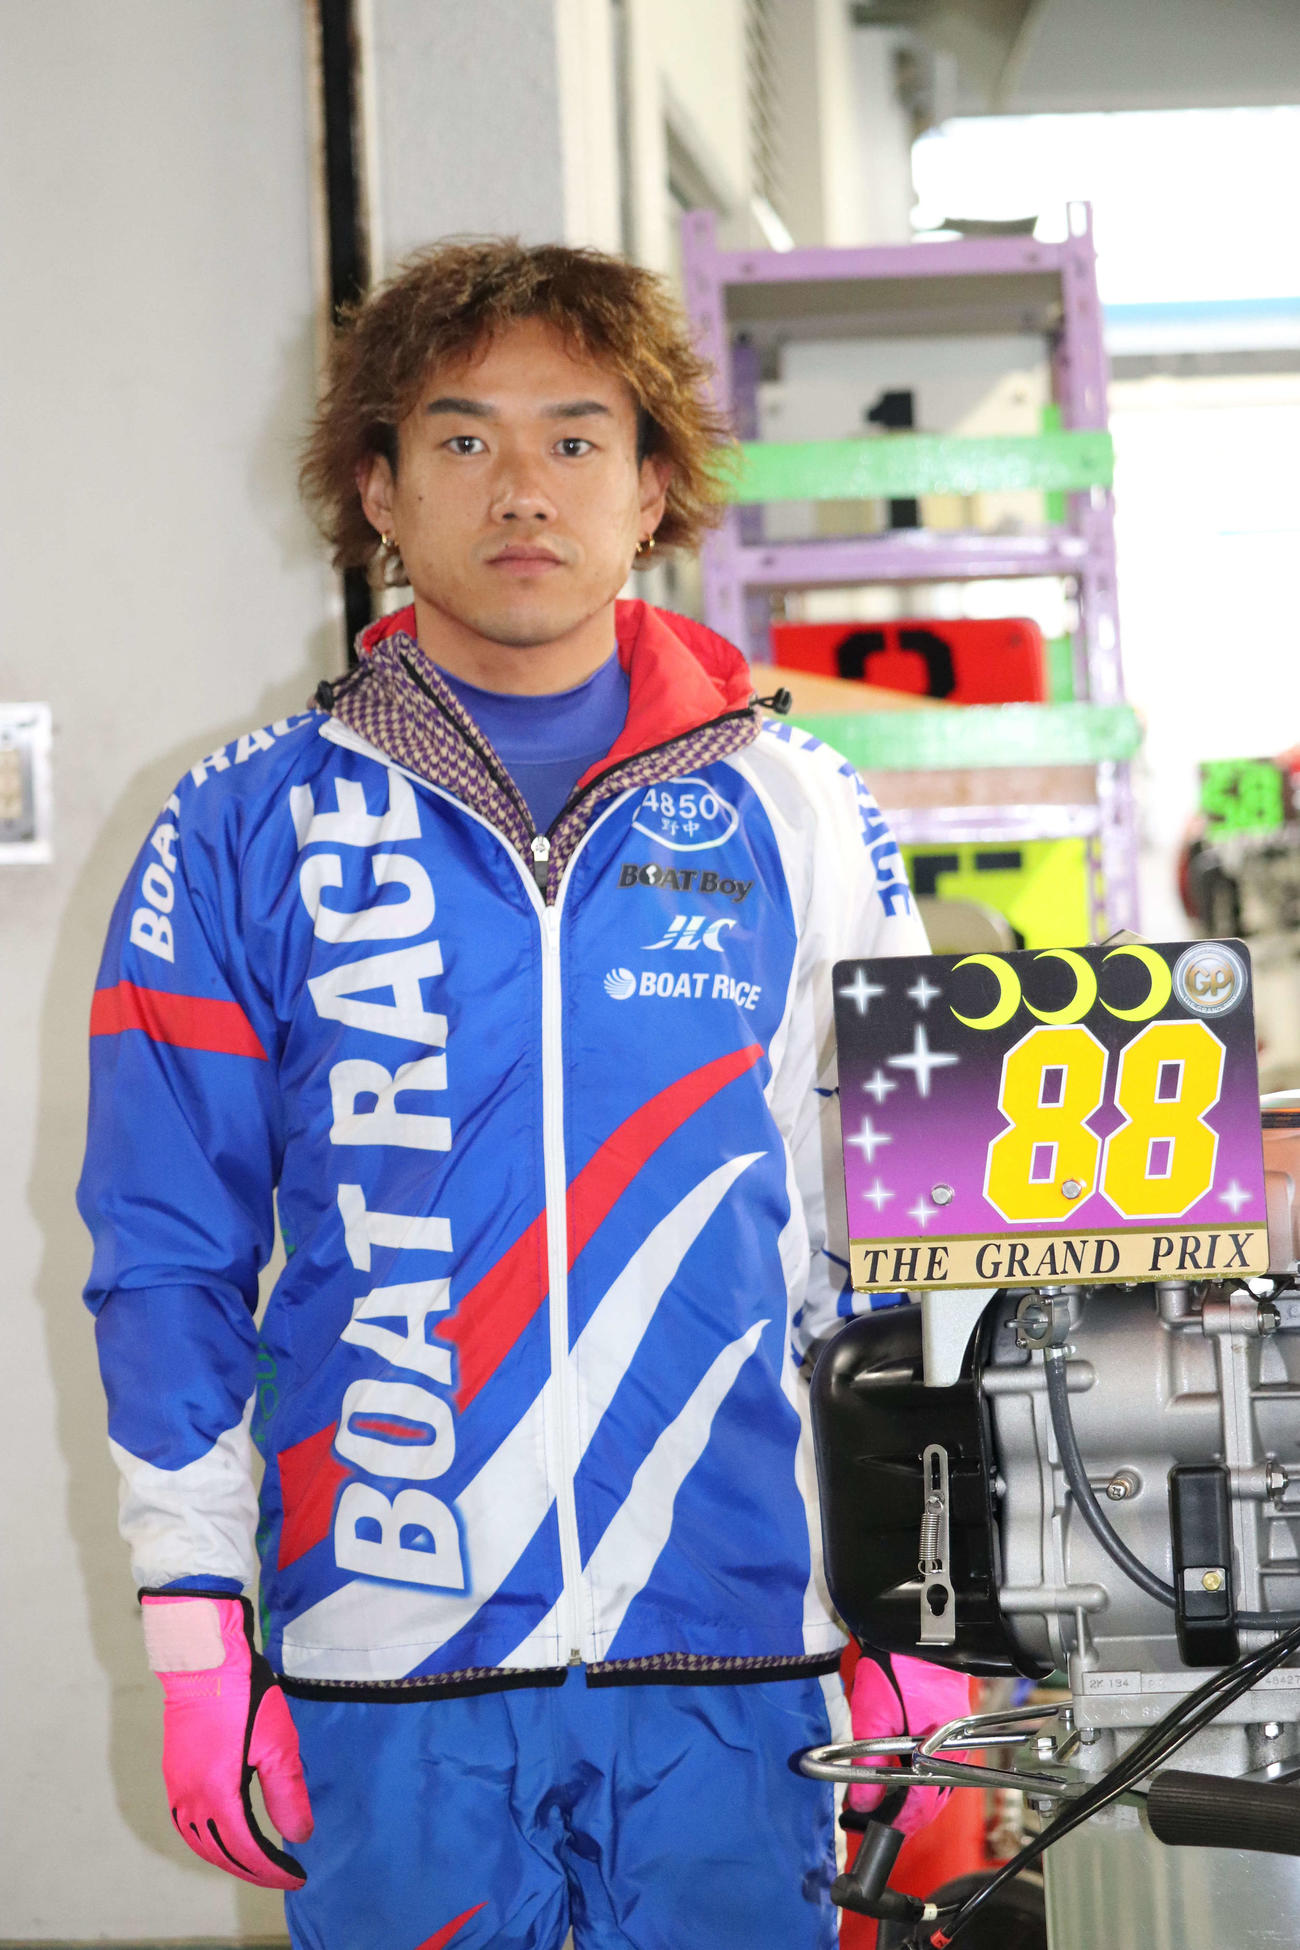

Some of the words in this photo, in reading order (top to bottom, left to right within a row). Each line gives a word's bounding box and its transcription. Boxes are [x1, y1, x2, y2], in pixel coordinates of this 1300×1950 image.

[641, 788, 719, 820] 4850
[660, 817, 700, 838] 野中
[616, 863, 698, 893] BOAT
[699, 870, 754, 904] Boy
[289, 767, 453, 1153] RACE
[1188, 965, 1233, 996] GP
[639, 972, 709, 999] BOAT
[982, 1019, 1227, 1224] 88
[863, 1245, 950, 1284] THE
[974, 1238, 1121, 1278] GRAND
[1149, 1232, 1255, 1272] PRIX
[335, 1184, 465, 1590] BOAT
